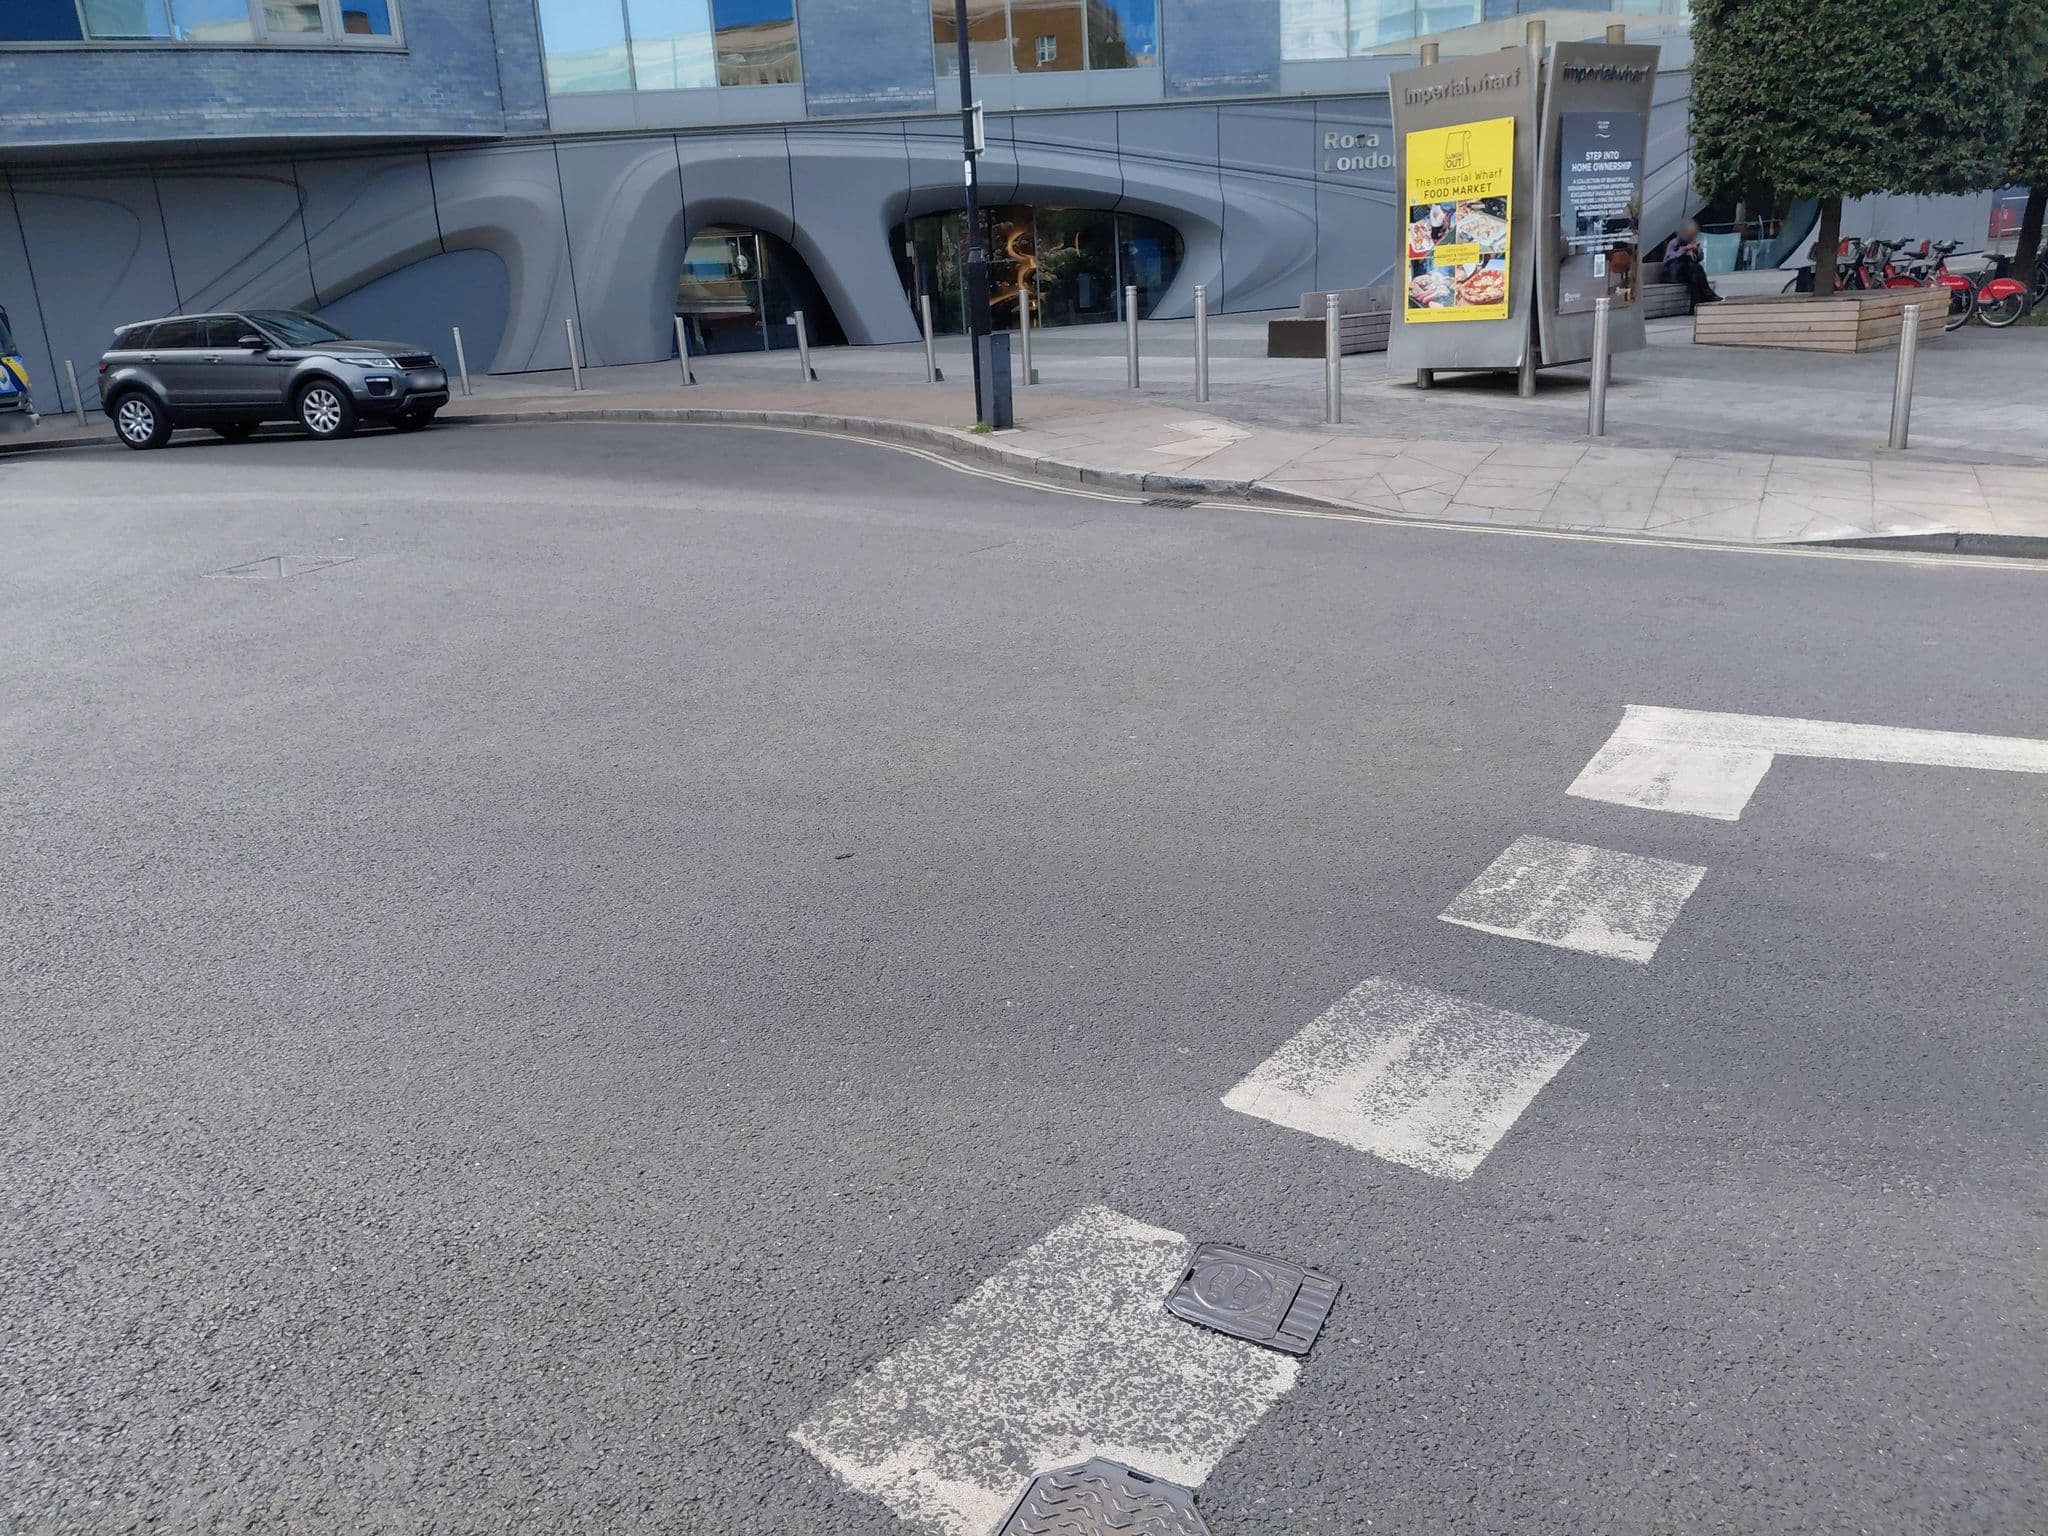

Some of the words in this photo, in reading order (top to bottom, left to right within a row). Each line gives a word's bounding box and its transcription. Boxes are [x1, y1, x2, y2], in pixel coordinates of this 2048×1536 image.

[1324, 131, 1379, 149] Roca
[1324, 151, 1396, 171] Londo
[1446, 159, 1462, 168] OUT
[1585, 151, 1602, 160] STEP
[1603, 151, 1619, 160] INTO
[1571, 163, 1592, 172] HOME
[1593, 161, 1632, 171] OWNERSHIP
[1416, 178, 1431, 187] The
[1434, 174, 1471, 185] Imperial
[1475, 168, 1503, 180] Wharf
[1424, 188, 1450, 199] FOOD
[1452, 182, 1492, 196] MARKET
